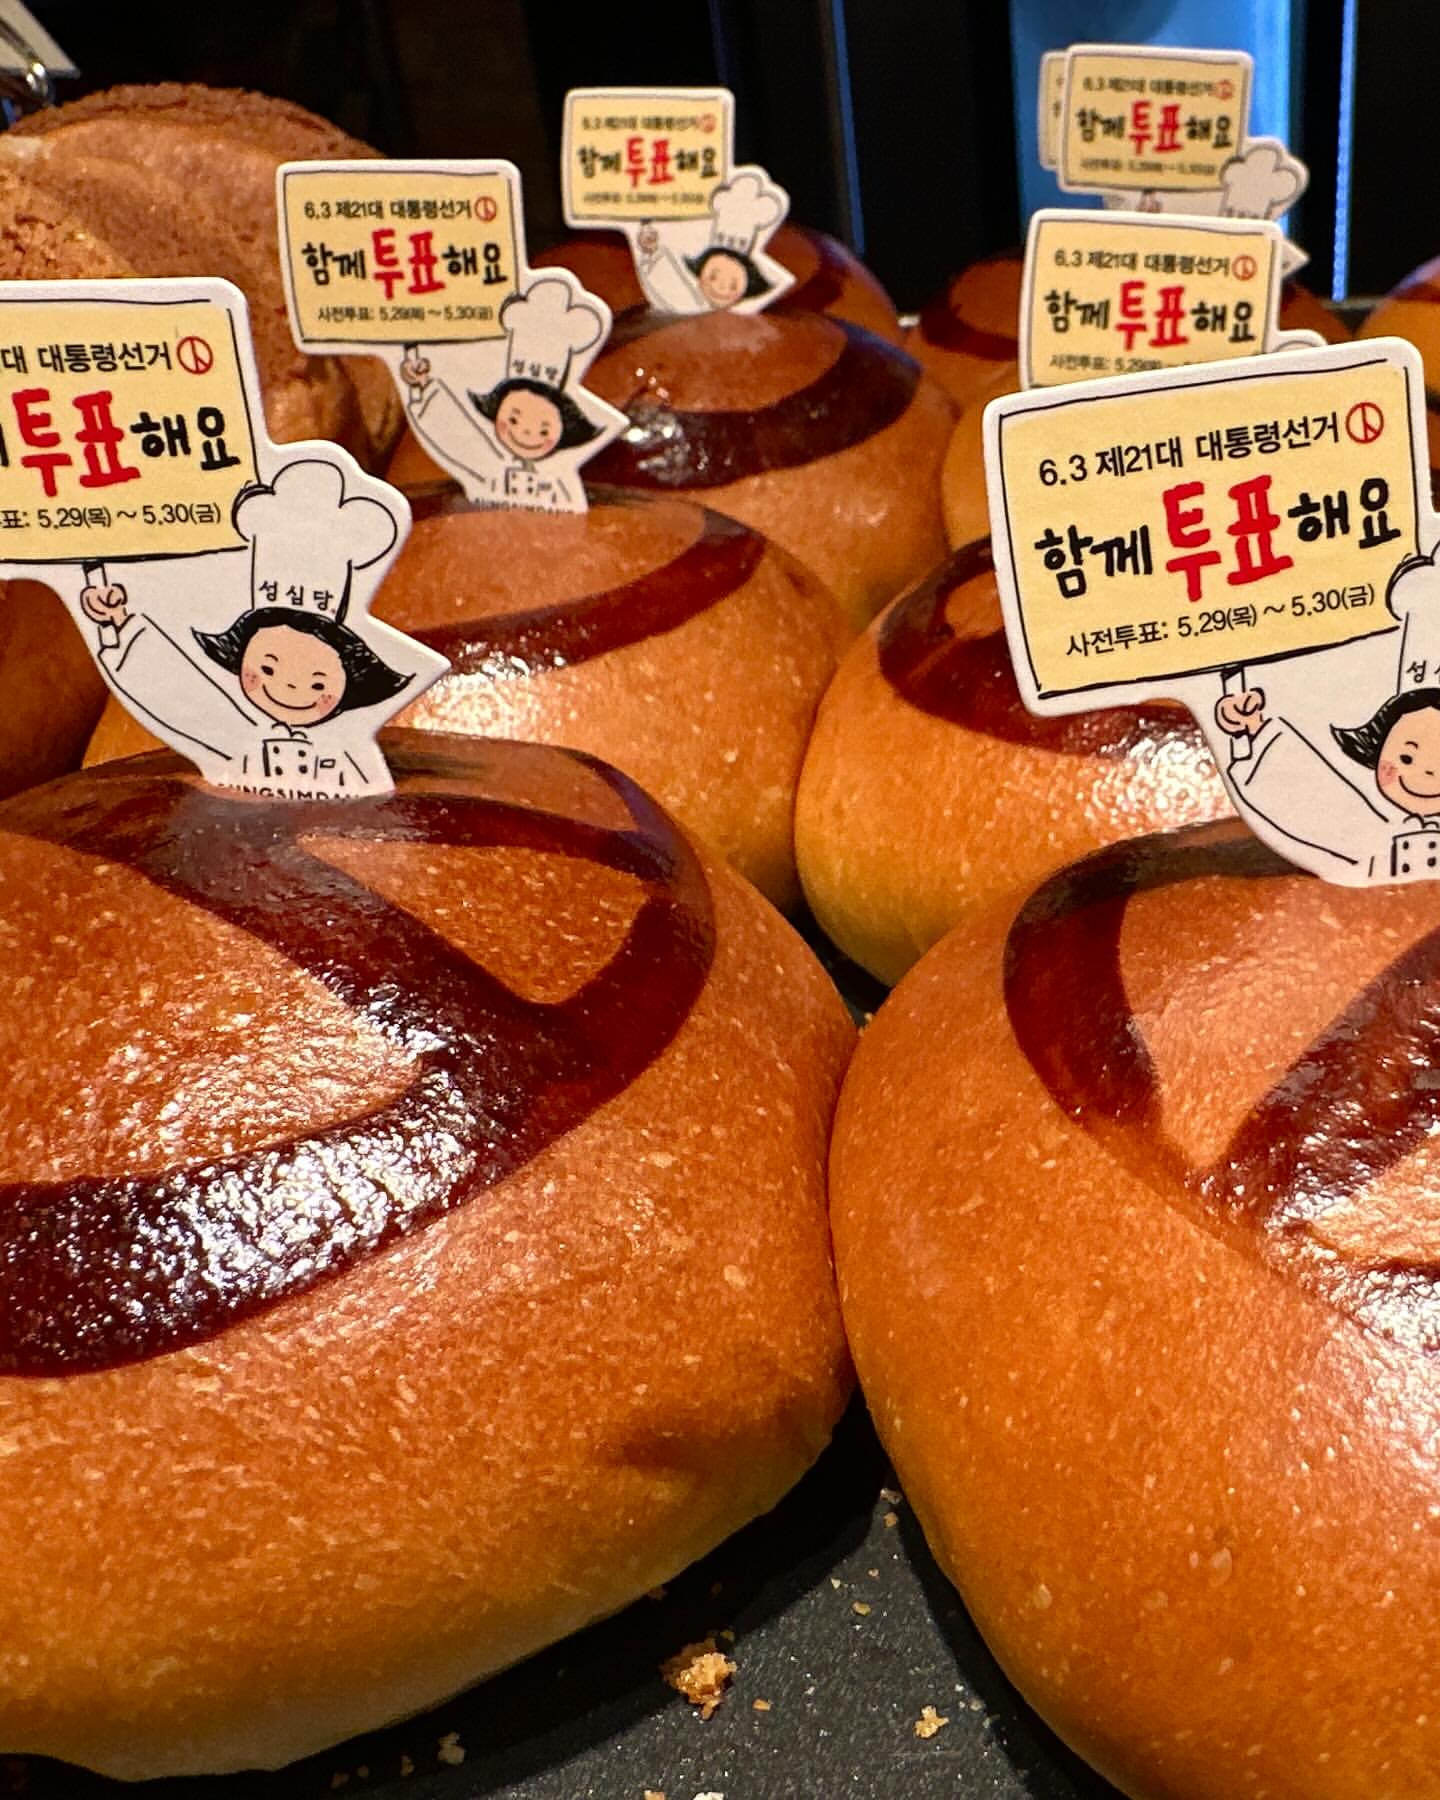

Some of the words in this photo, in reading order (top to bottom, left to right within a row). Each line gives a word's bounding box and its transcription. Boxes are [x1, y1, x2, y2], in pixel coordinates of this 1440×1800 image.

[1075, 107, 1125, 143] 함께
[577, 145, 622, 179] 함께
[303, 200, 332, 220] 6.3
[389, 199, 472, 220] 대통령선거
[301, 241, 367, 286] 함께
[371, 228, 508, 300] 투표해요
[1054, 249, 1083, 268] 6.3
[1144, 253, 1230, 277] 대통령선거
[1044, 289, 1111, 333] 함께
[1114, 280, 1256, 351] 투표해요
[37, 341, 173, 374] 대통령선거
[11, 388, 241, 498] 투표해요
[1038, 454, 1088, 487] 6.3
[1095, 436, 1184, 477] 제21대
[1195, 411, 1340, 461] 대통령선거
[37, 506, 112, 530] 5.29(목)
[143, 501, 221, 526] 5.30(금)
[1034, 524, 1154, 600] 함께
[1162, 474, 1401, 602] 투표해요
[1066, 621, 1169, 657] 사전투표:
[1177, 604, 1258, 638] 5.29(목)
[1291, 583, 1375, 617] 5.30(금)
